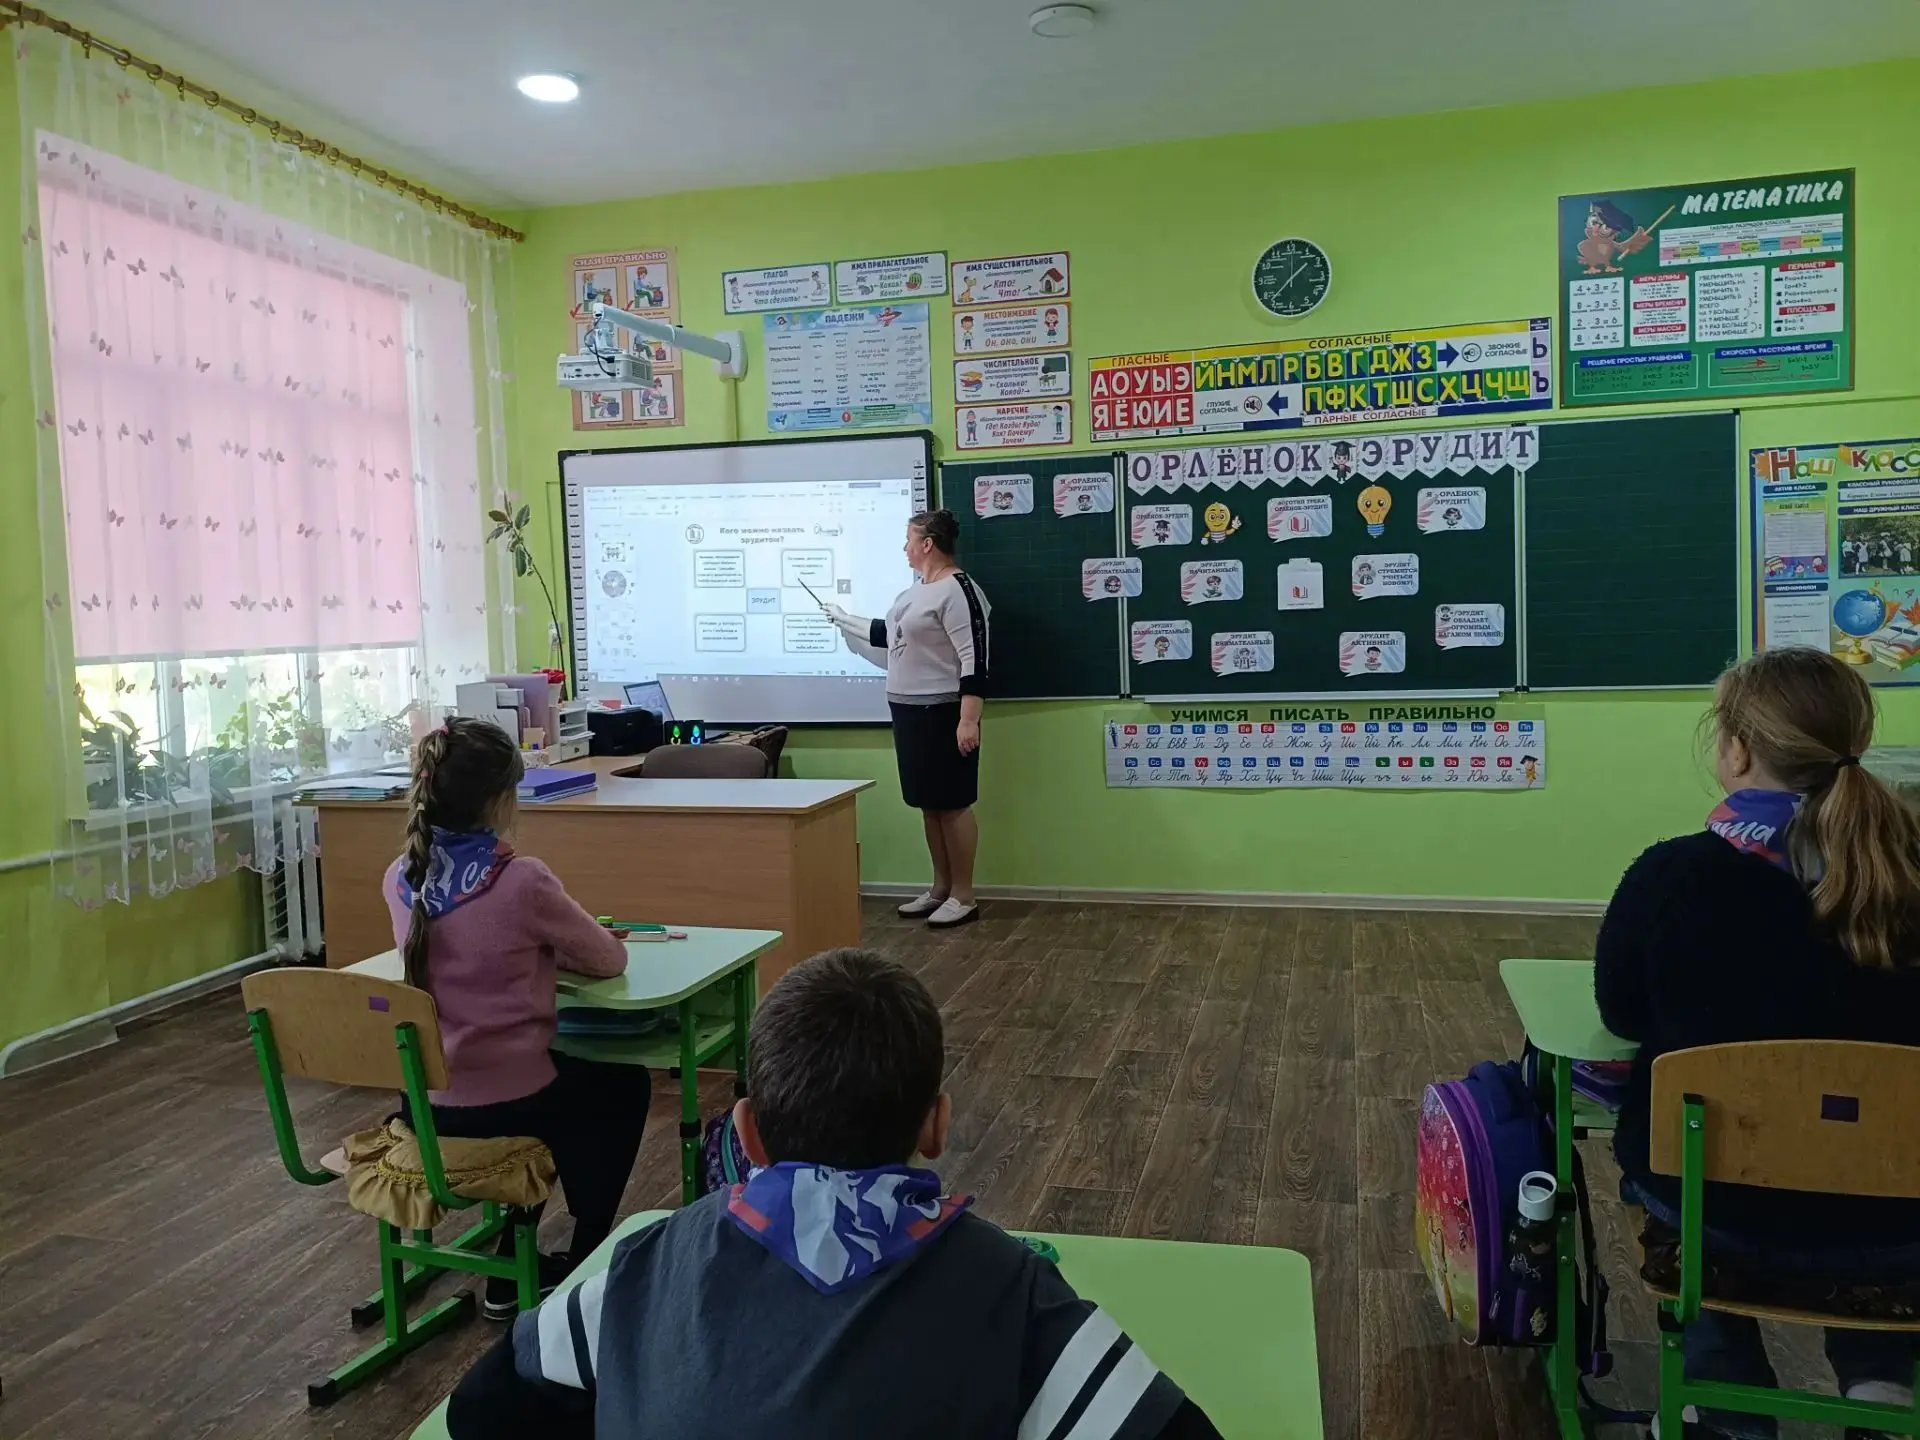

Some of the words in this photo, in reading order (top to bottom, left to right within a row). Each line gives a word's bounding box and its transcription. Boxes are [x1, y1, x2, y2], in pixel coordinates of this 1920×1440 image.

[1681, 180, 1844, 216] МАТЕМАТИКА
[605, 251, 667, 264] ПРАВИЛЬНО
[851, 262, 866, 271] ИМЯ
[867, 256, 929, 269] ПРИЛАГАТЕЛЬНОЕ
[966, 264, 982, 272] ИМЯ
[983, 257, 1054, 270] СУЩЕСТВИТЕЛЬНОЕ
[763, 270, 788, 279] ГЛАГОЛ
[993, 279, 1016, 288] Кто?
[983, 308, 1037, 320] МЕСТОИМЕНИЕ
[1786, 304, 1828, 314] ПЛОЩАДЬ
[825, 312, 865, 324] ПАДЕЖИ
[1308, 333, 1392, 349] СОГЛАСНЫЕ
[1487, 341, 1520, 350] ЗВОНКИЕ
[1484, 348, 1528, 358] СОГЛАСНЫЕ
[983, 357, 1039, 369] ЧИСЛИТЕЛЬНОЕ
[1112, 353, 1170, 367] ГЛАСНЫЕ
[1206, 399, 1231, 408] ГЛУХИЕ
[996, 406, 1030, 415] НАРЕЧИЕ
[1199, 405, 1239, 415] СОГЛАСНЫЕ
[1314, 413, 1358, 424] ПАРНЫЕ
[1363, 408, 1427, 420] СОГЛАСНЫЕ
[1132, 444, 1322, 482] ОРЛЁНОК
[1362, 430, 1536, 467] ЭРУДИТ
[1853, 506, 1868, 514] НАШ
[719, 527, 739, 535] Кого
[740, 536, 784, 544] эрудитом?
[751, 596, 776, 604] ЭРУДИТ
[1171, 708, 1249, 722] УЧИМСЯ
[1269, 708, 1350, 721] ПИСАТЬ
[1369, 706, 1496, 720] ПРАВИЛЬНО
